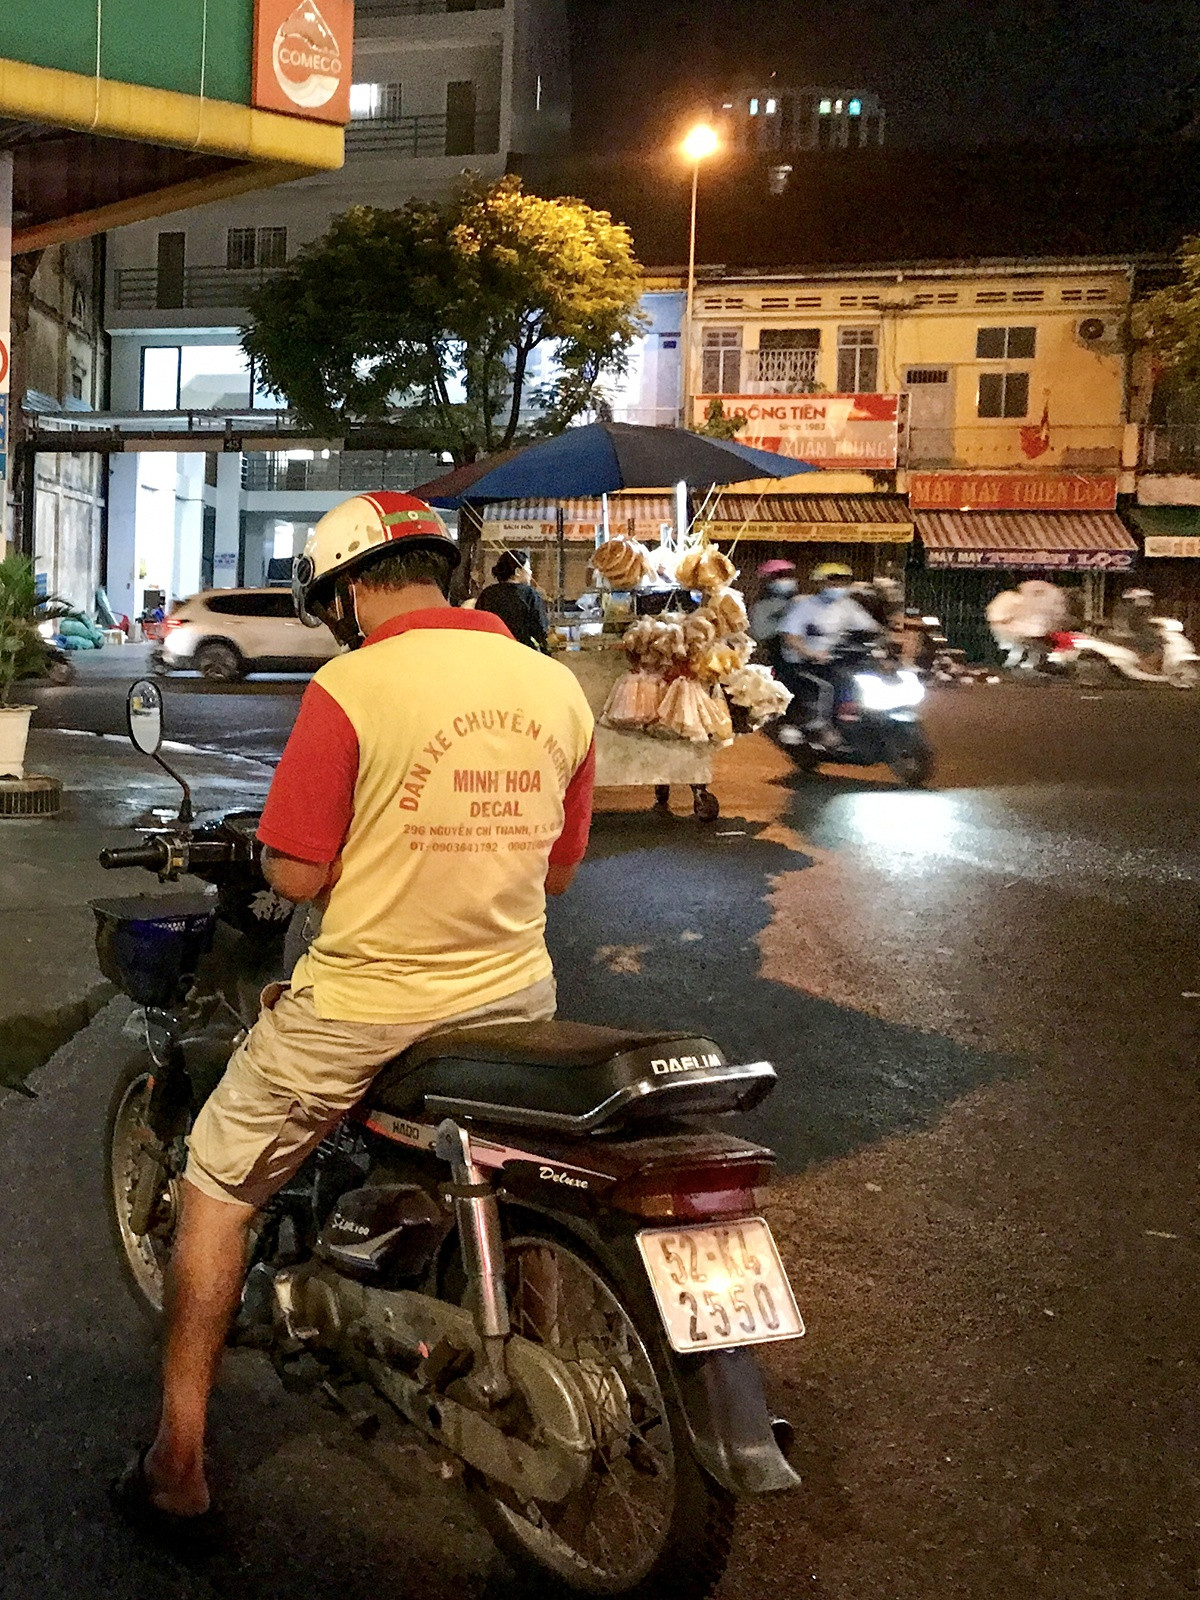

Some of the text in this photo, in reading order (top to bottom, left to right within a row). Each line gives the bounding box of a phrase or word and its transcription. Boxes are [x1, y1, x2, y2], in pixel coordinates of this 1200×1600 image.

[279, 48, 342, 74] COMECO
[422, 729, 453, 764] XE
[453, 707, 542, 741] CHUYÊN
[453, 769, 541, 793] MINH HOA
[469, 800, 524, 818] DECAL
[650, 1053, 722, 1075] DAELIM
[538, 1166, 589, 1189] Deluxe
[678, 1282, 781, 1342] 2550
